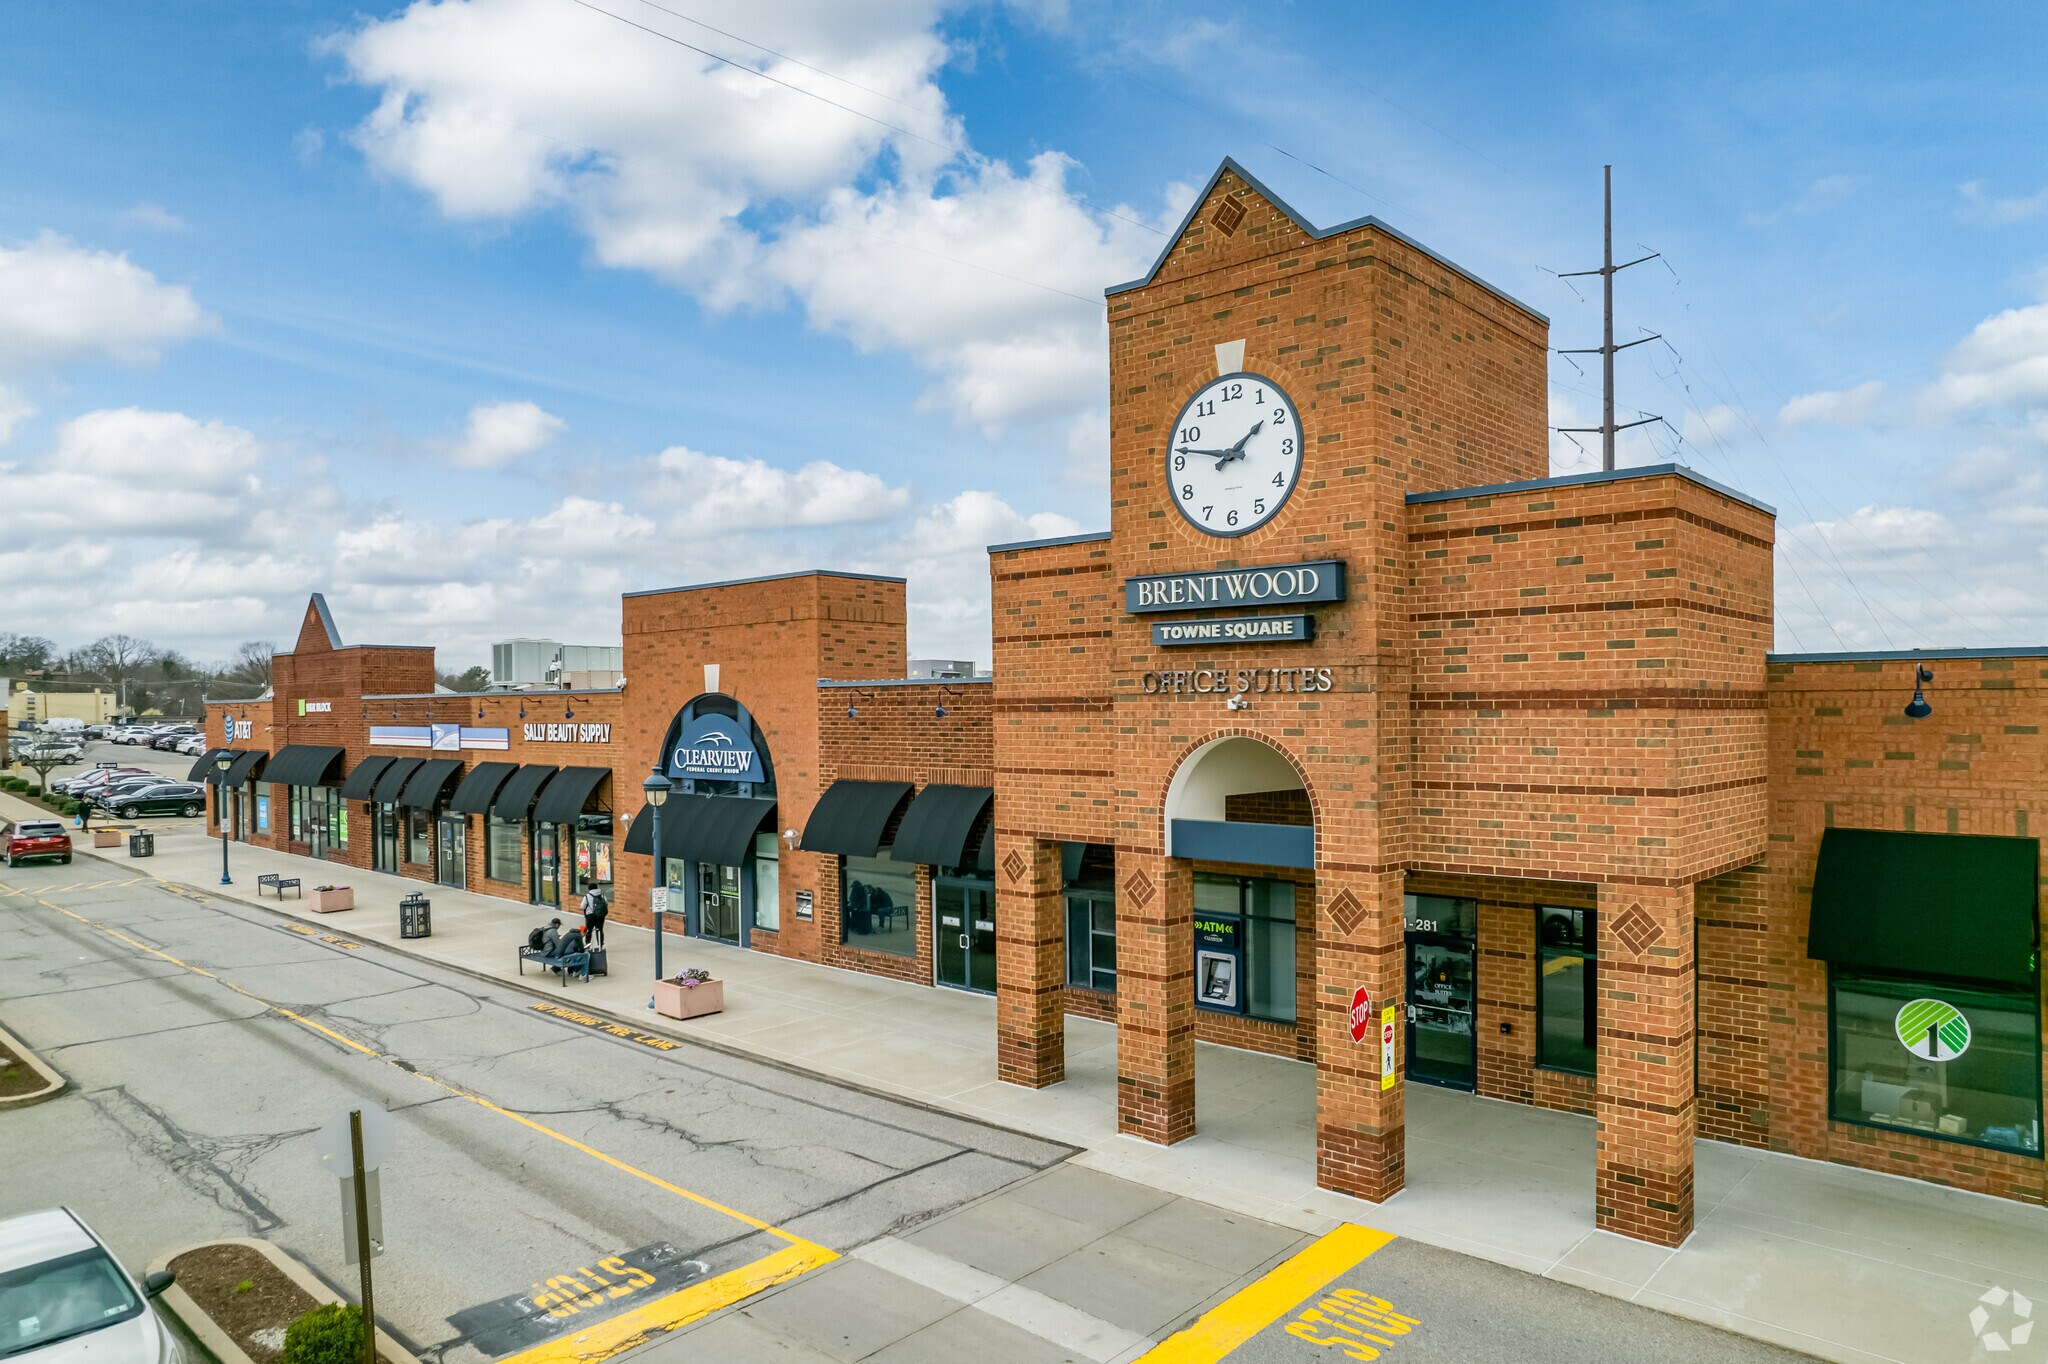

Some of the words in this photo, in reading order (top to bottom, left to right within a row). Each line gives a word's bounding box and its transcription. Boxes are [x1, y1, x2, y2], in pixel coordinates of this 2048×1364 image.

[1221, 383, 1243, 402] 12
[1255, 388, 1265, 405] 1
[1197, 400, 1216, 417] 11
[1273, 408, 1286, 426] 2
[1180, 426, 1200, 444] 10
[1281, 438, 1294, 455] 3
[1174, 455, 1185, 472] 9
[1272, 471, 1285, 488] 4
[1182, 484, 1194, 500] 8
[1202, 505, 1214, 521] 7
[1254, 498, 1265, 515] 5
[1226, 510, 1238, 526] 6
[1137, 568, 1320, 606] BRENTWOOD
[1160, 624, 1220, 640] TOWNE
[1224, 620, 1293, 639] SQUARE
[1141, 669, 1230, 694] OFFICE
[1236, 667, 1332, 693] SUITES
[234, 721, 252, 739] AT&T
[524, 723, 546, 741] SALLY
[547, 723, 578, 742] BEAUTY
[580, 723, 610, 743] SUPPLY
[686, 766, 706, 774] FEDERAL
[1203, 921, 1225, 933] ATM
[1351, 1000, 1368, 1030] STOP
[598, 1024, 638, 1037] FIRE
[633, 1035, 682, 1051] LANE
[1384, 1031, 1393, 1040] STOP
[532, 1257, 657, 1318] STOP
[1284, 1288, 1421, 1361] STOP
